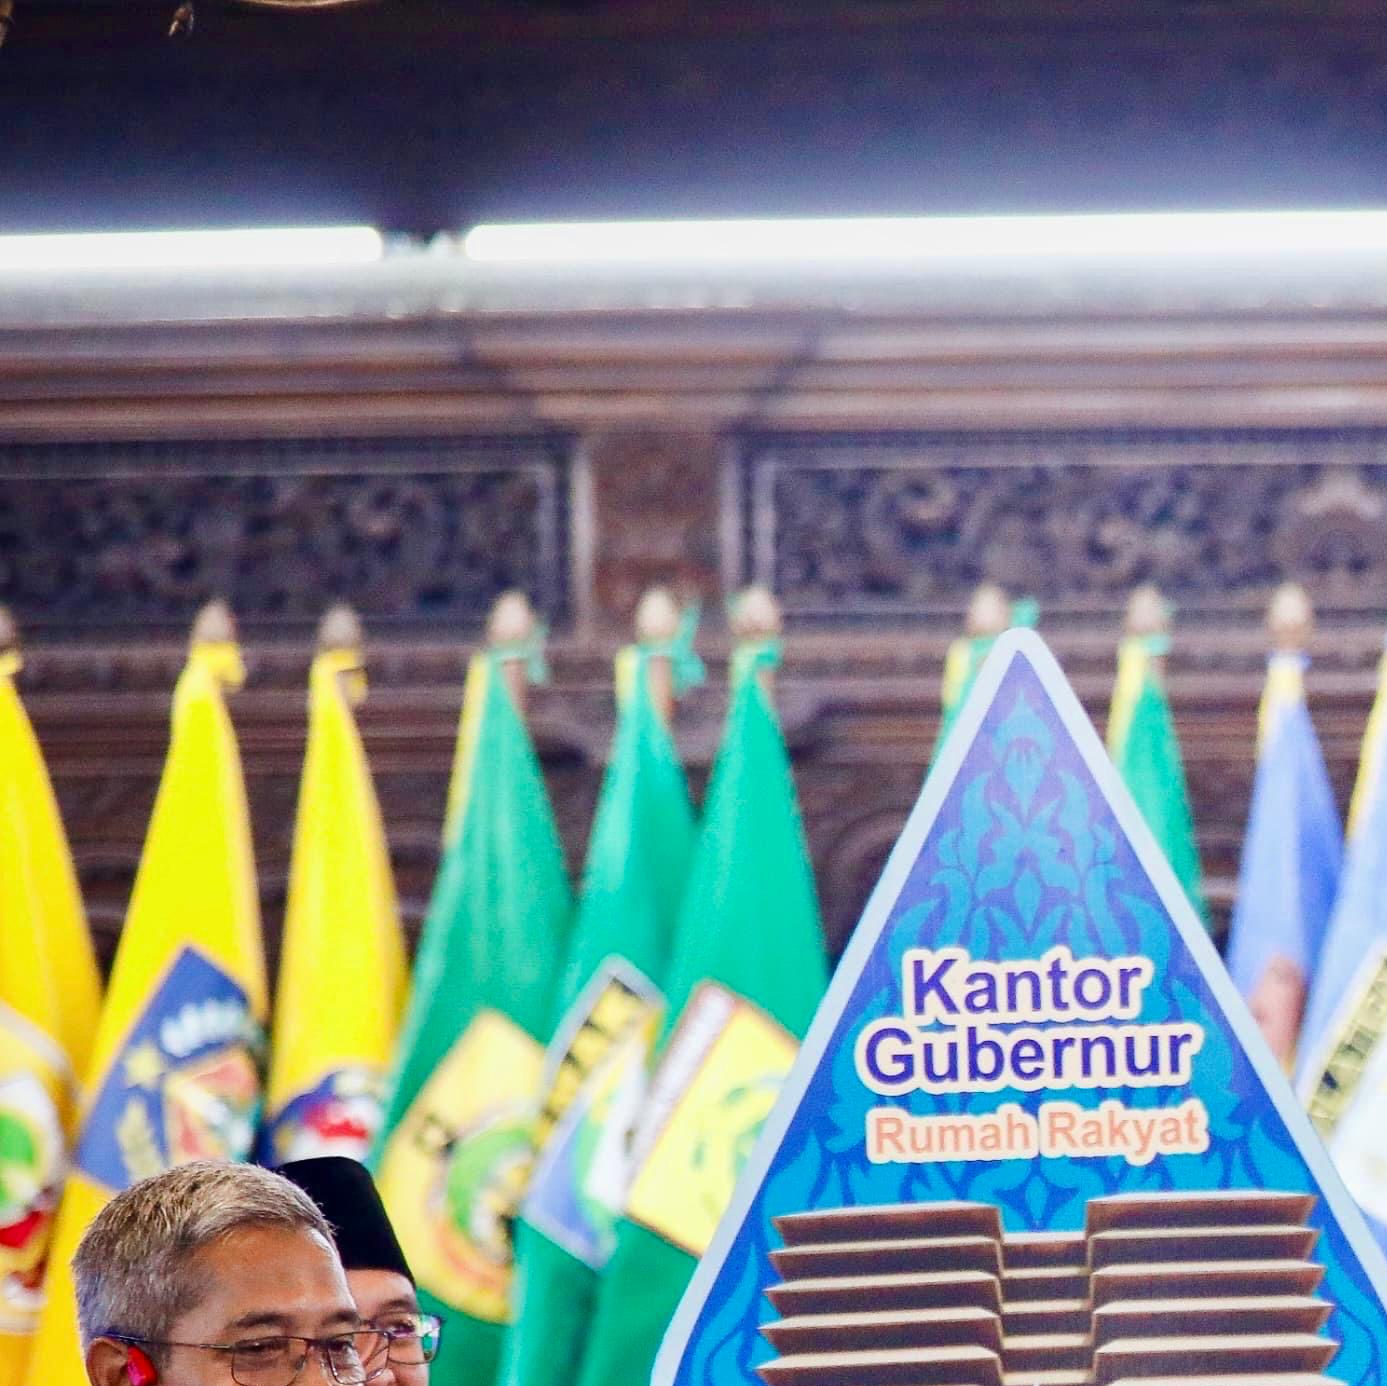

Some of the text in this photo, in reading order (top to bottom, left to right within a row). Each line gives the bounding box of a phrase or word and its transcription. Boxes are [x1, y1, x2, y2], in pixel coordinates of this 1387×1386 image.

[912, 957, 1143, 1016] Kantor
[864, 1026, 1193, 1085] Gubernur
[874, 1109, 1200, 1156] Rumah Rakyat
